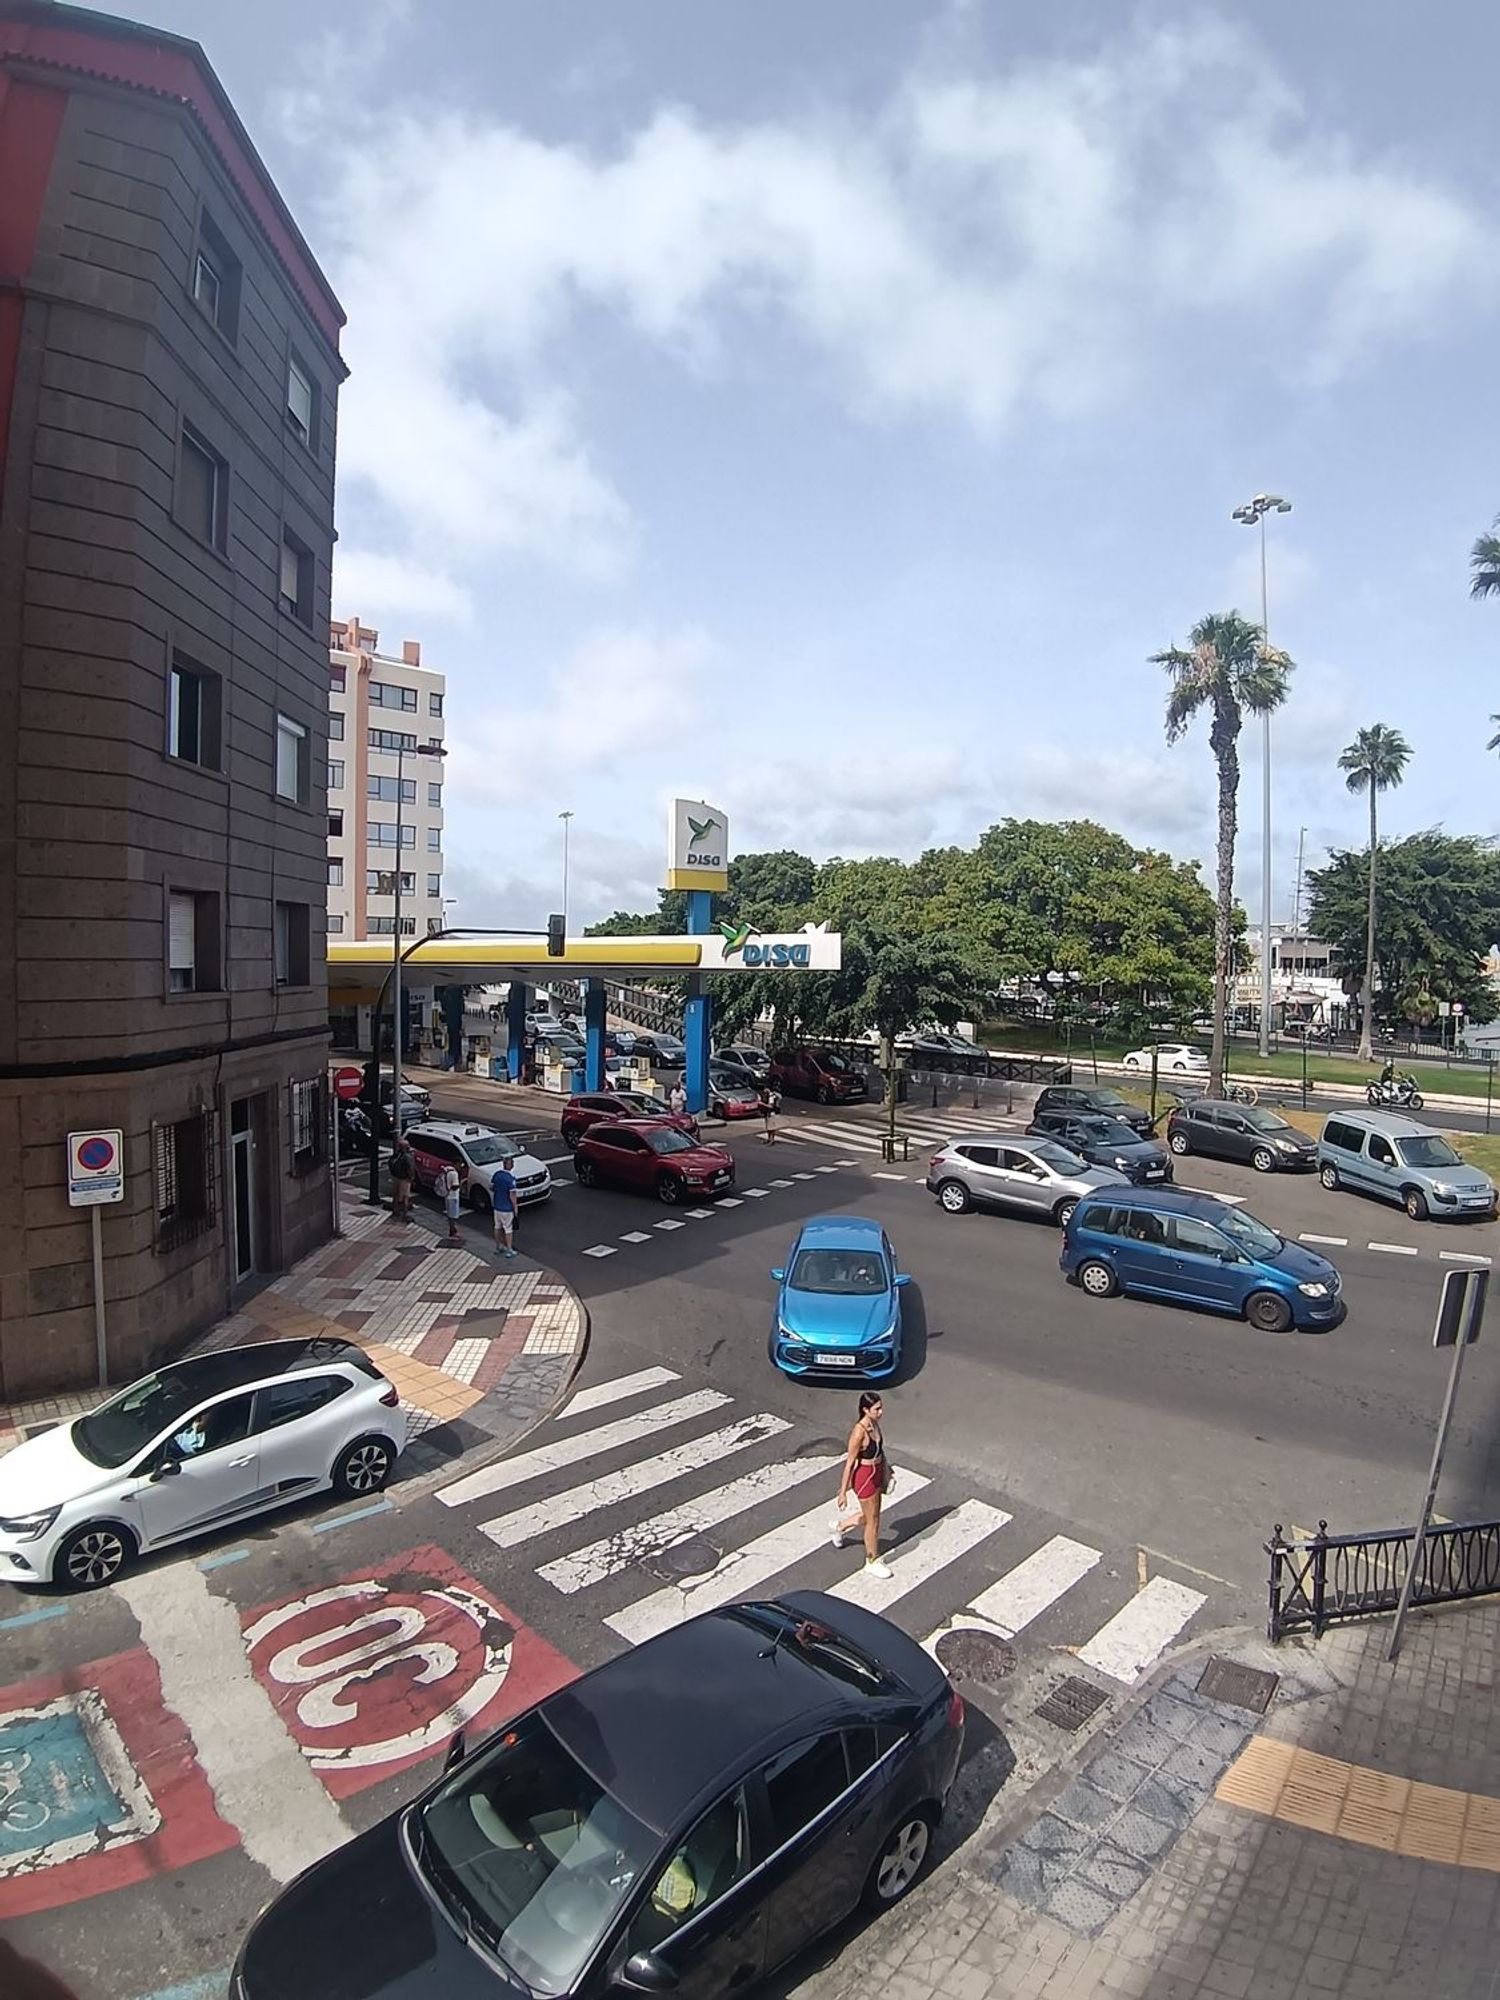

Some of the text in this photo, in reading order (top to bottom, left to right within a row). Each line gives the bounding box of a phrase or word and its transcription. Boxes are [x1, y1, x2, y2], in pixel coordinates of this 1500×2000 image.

[687, 854, 720, 866] DISA
[742, 944, 811, 967] DISA
[268, 1606, 460, 1729] 30
